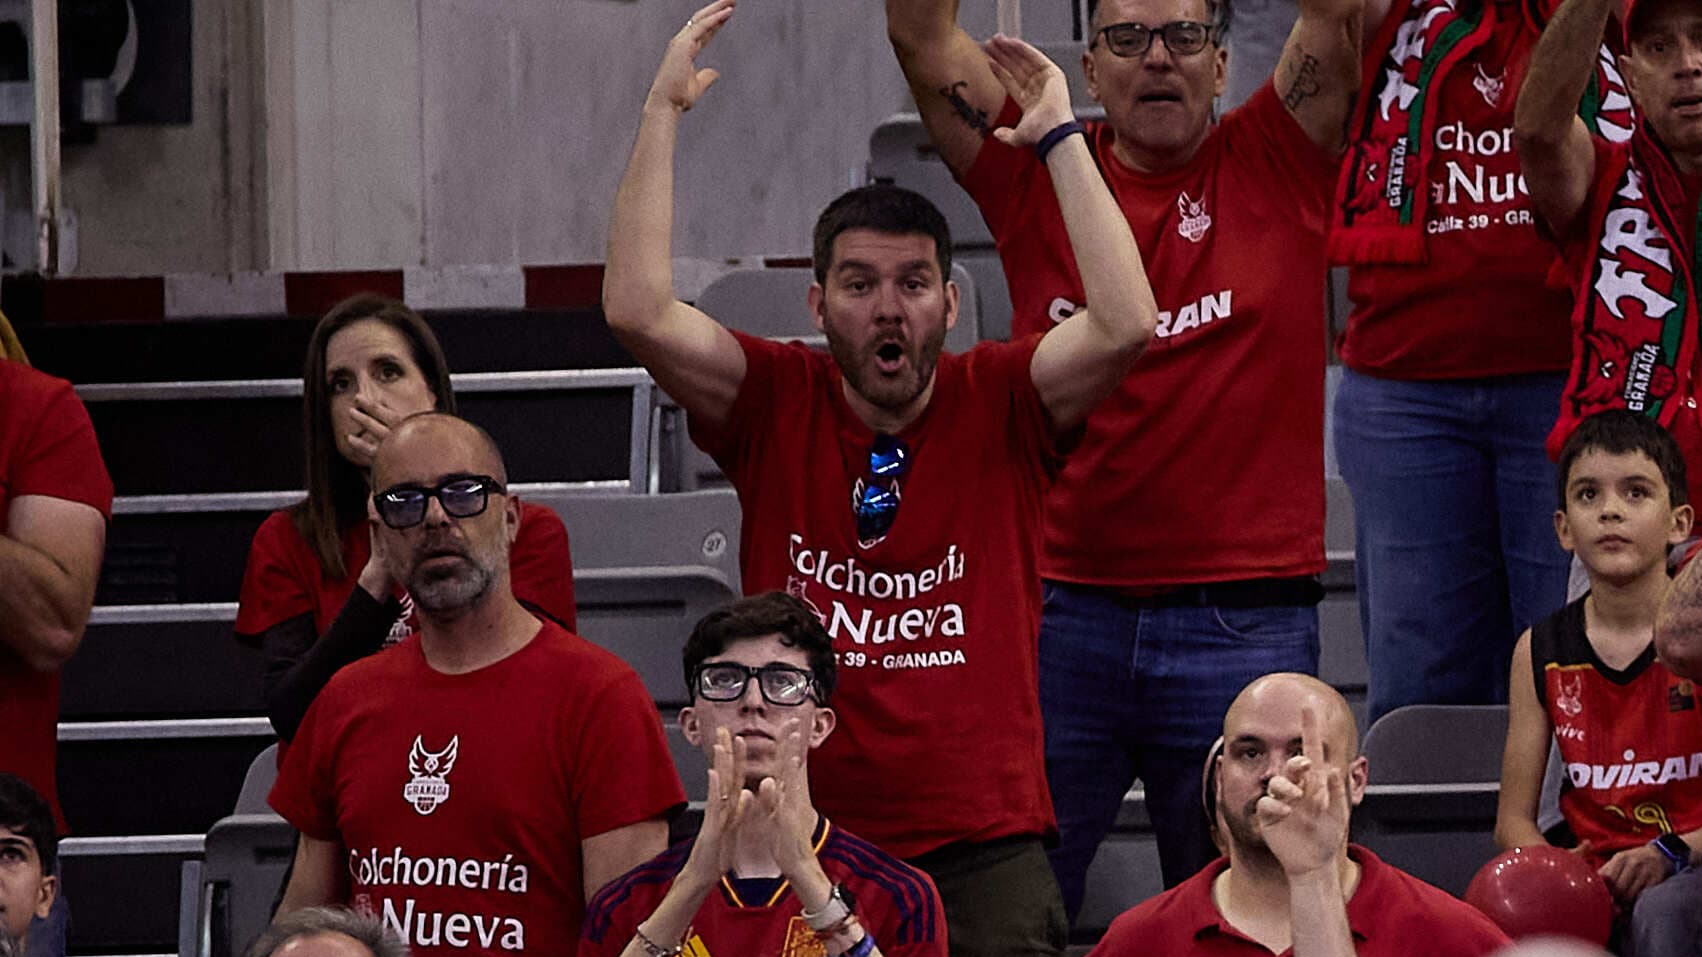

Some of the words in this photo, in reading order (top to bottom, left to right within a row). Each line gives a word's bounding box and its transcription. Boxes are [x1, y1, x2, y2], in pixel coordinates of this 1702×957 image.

[1467, 214, 1489, 230] 39
[1628, 343, 1660, 412] GRANADA
[827, 600, 966, 645] Nueva
[844, 651, 866, 668] 39
[882, 649, 966, 670] GRANADA
[382, 897, 525, 951] Nueva
